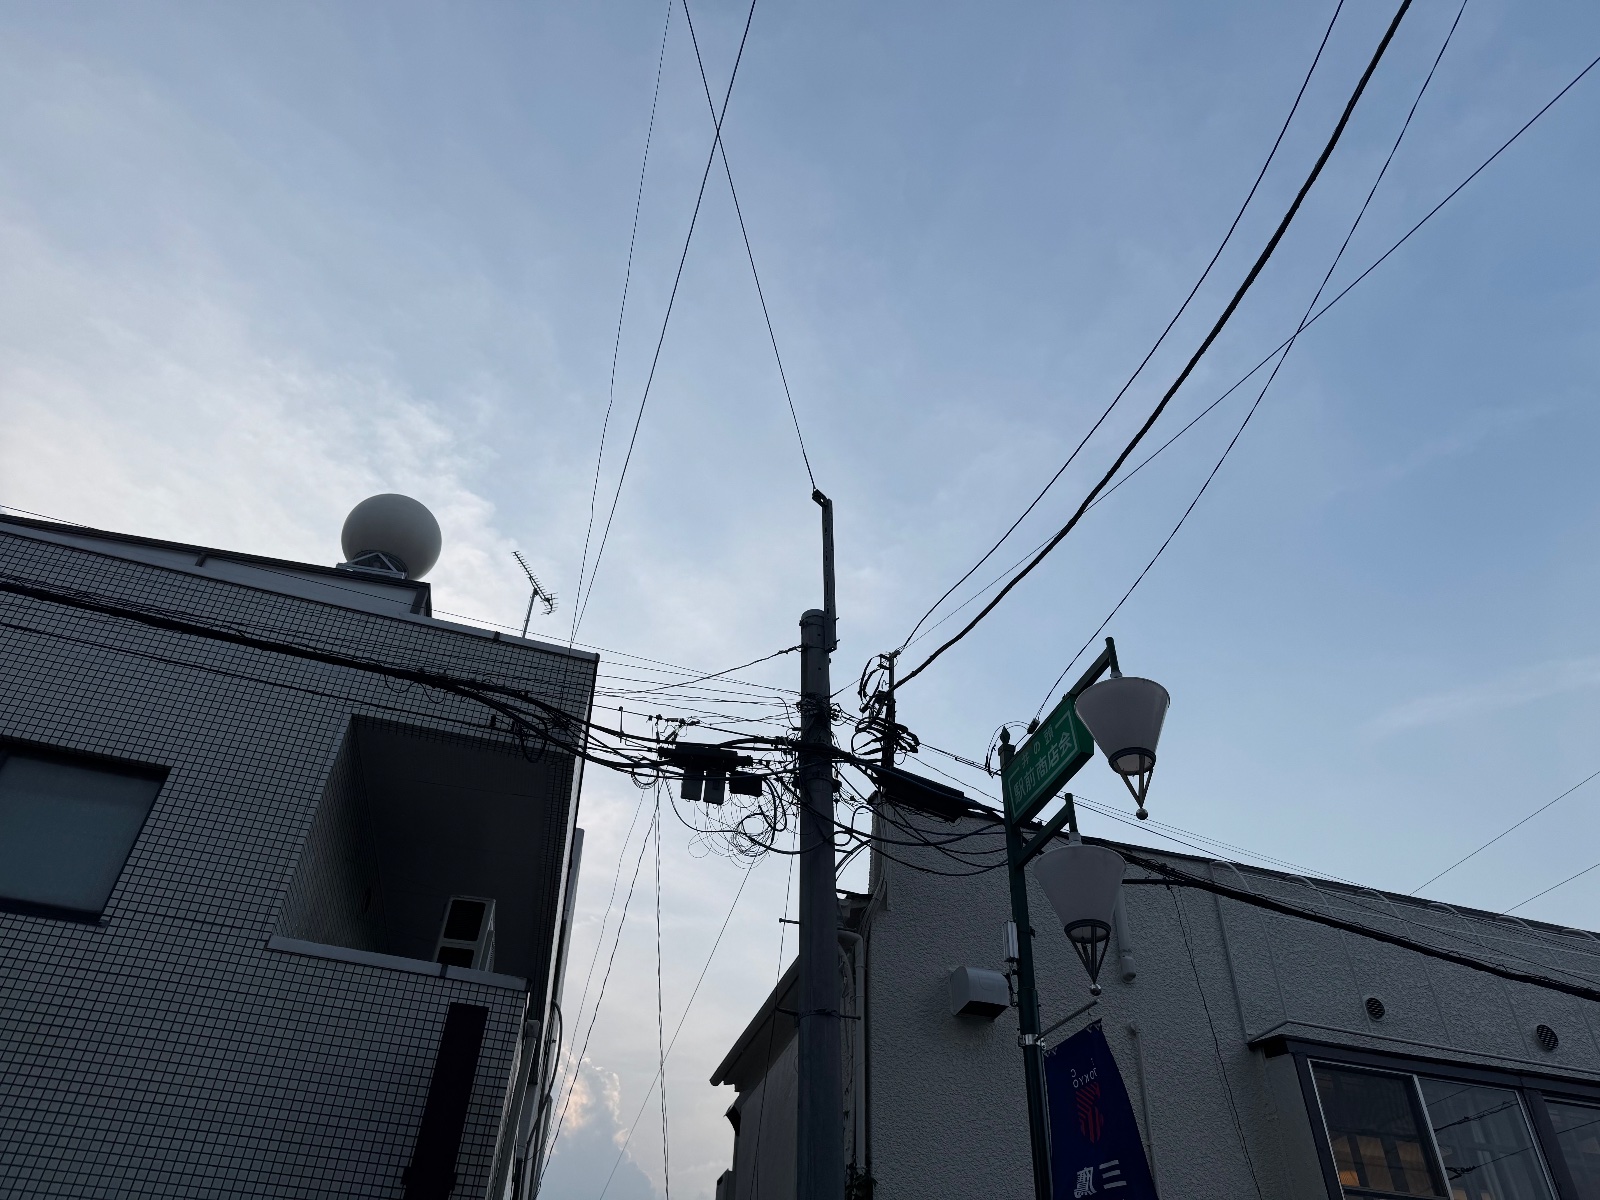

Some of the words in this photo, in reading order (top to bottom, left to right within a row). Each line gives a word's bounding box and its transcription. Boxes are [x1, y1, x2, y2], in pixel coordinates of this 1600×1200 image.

[1014, 732, 1072, 804] 駅前商店会
[1022, 724, 1054, 769] 井の頭
